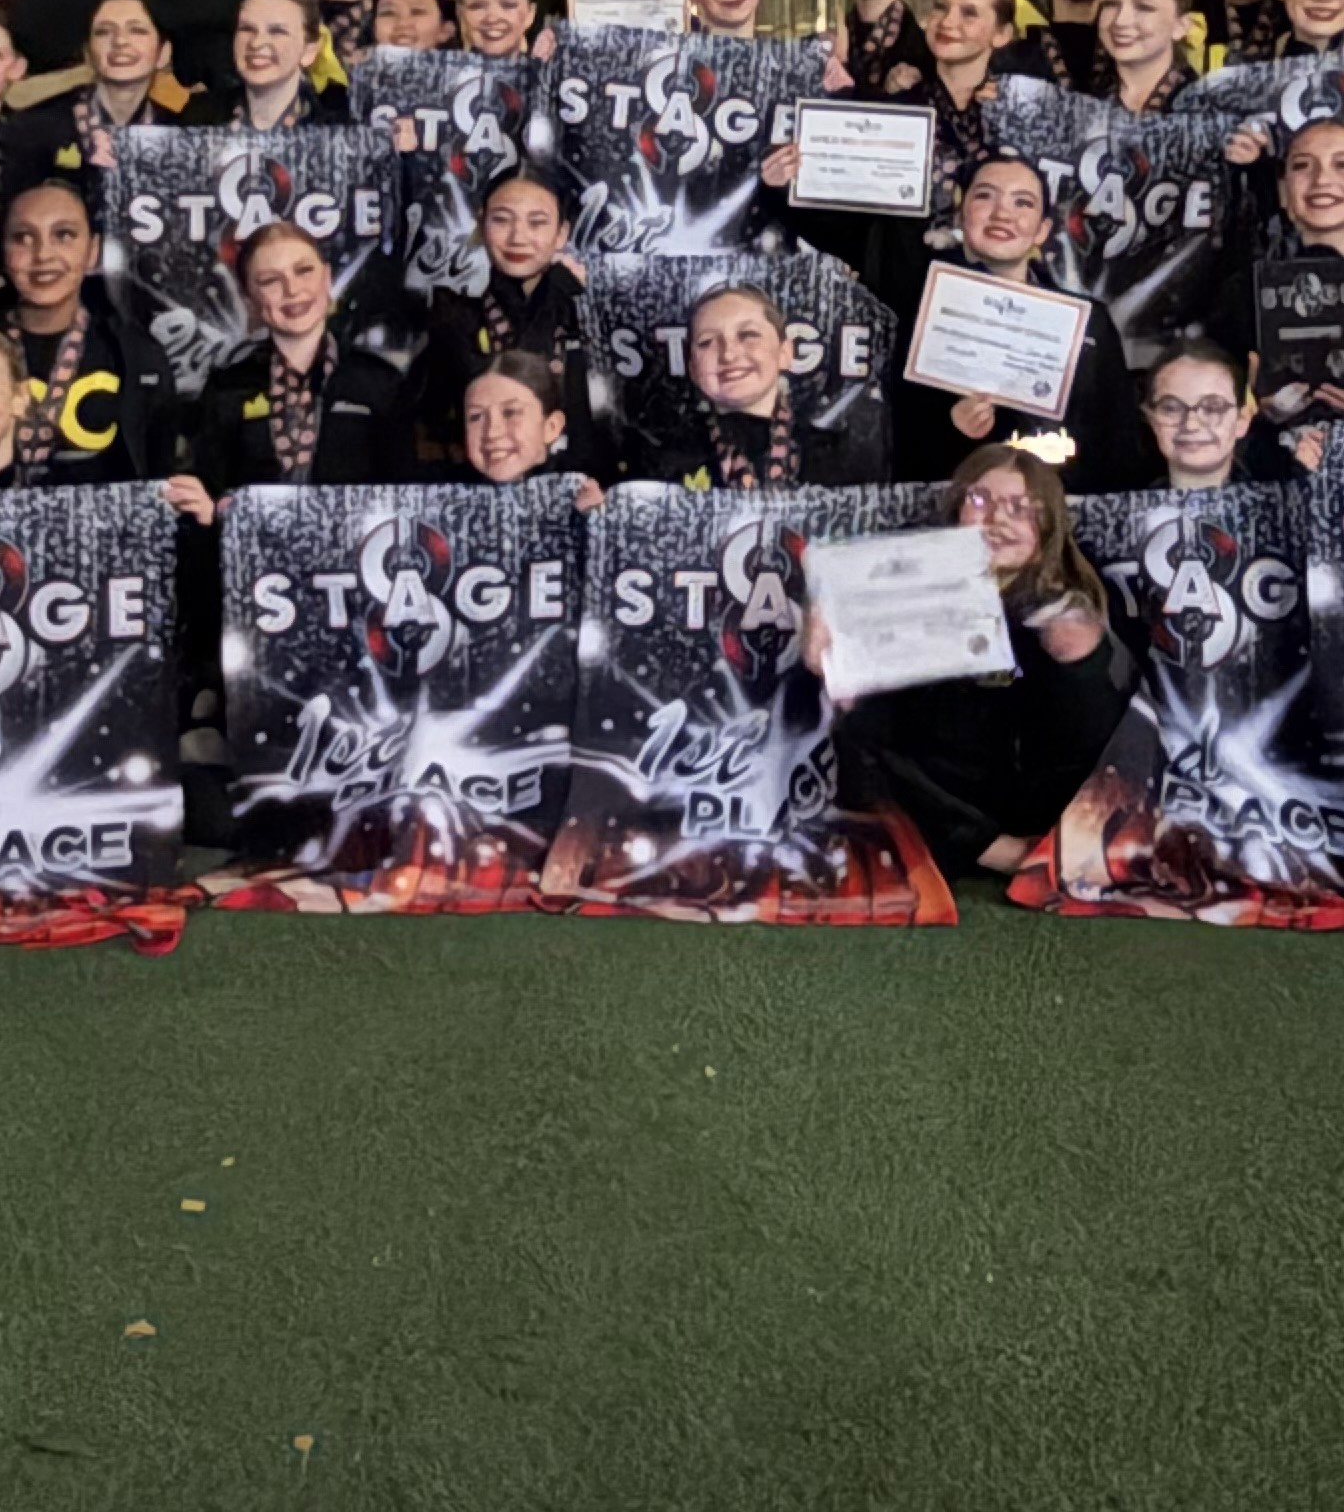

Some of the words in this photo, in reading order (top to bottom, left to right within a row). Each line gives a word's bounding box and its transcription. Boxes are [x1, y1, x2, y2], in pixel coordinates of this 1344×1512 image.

[560, 77, 797, 145] STAGE
[128, 188, 382, 244] STAGE
[1038, 158, 1213, 229] TAGE
[610, 322, 870, 378] STGE
[255, 560, 564, 634] STAGE
[613, 569, 797, 630] STA
[1102, 557, 1299, 620] TAG
[634, 697, 770, 787] 1st
